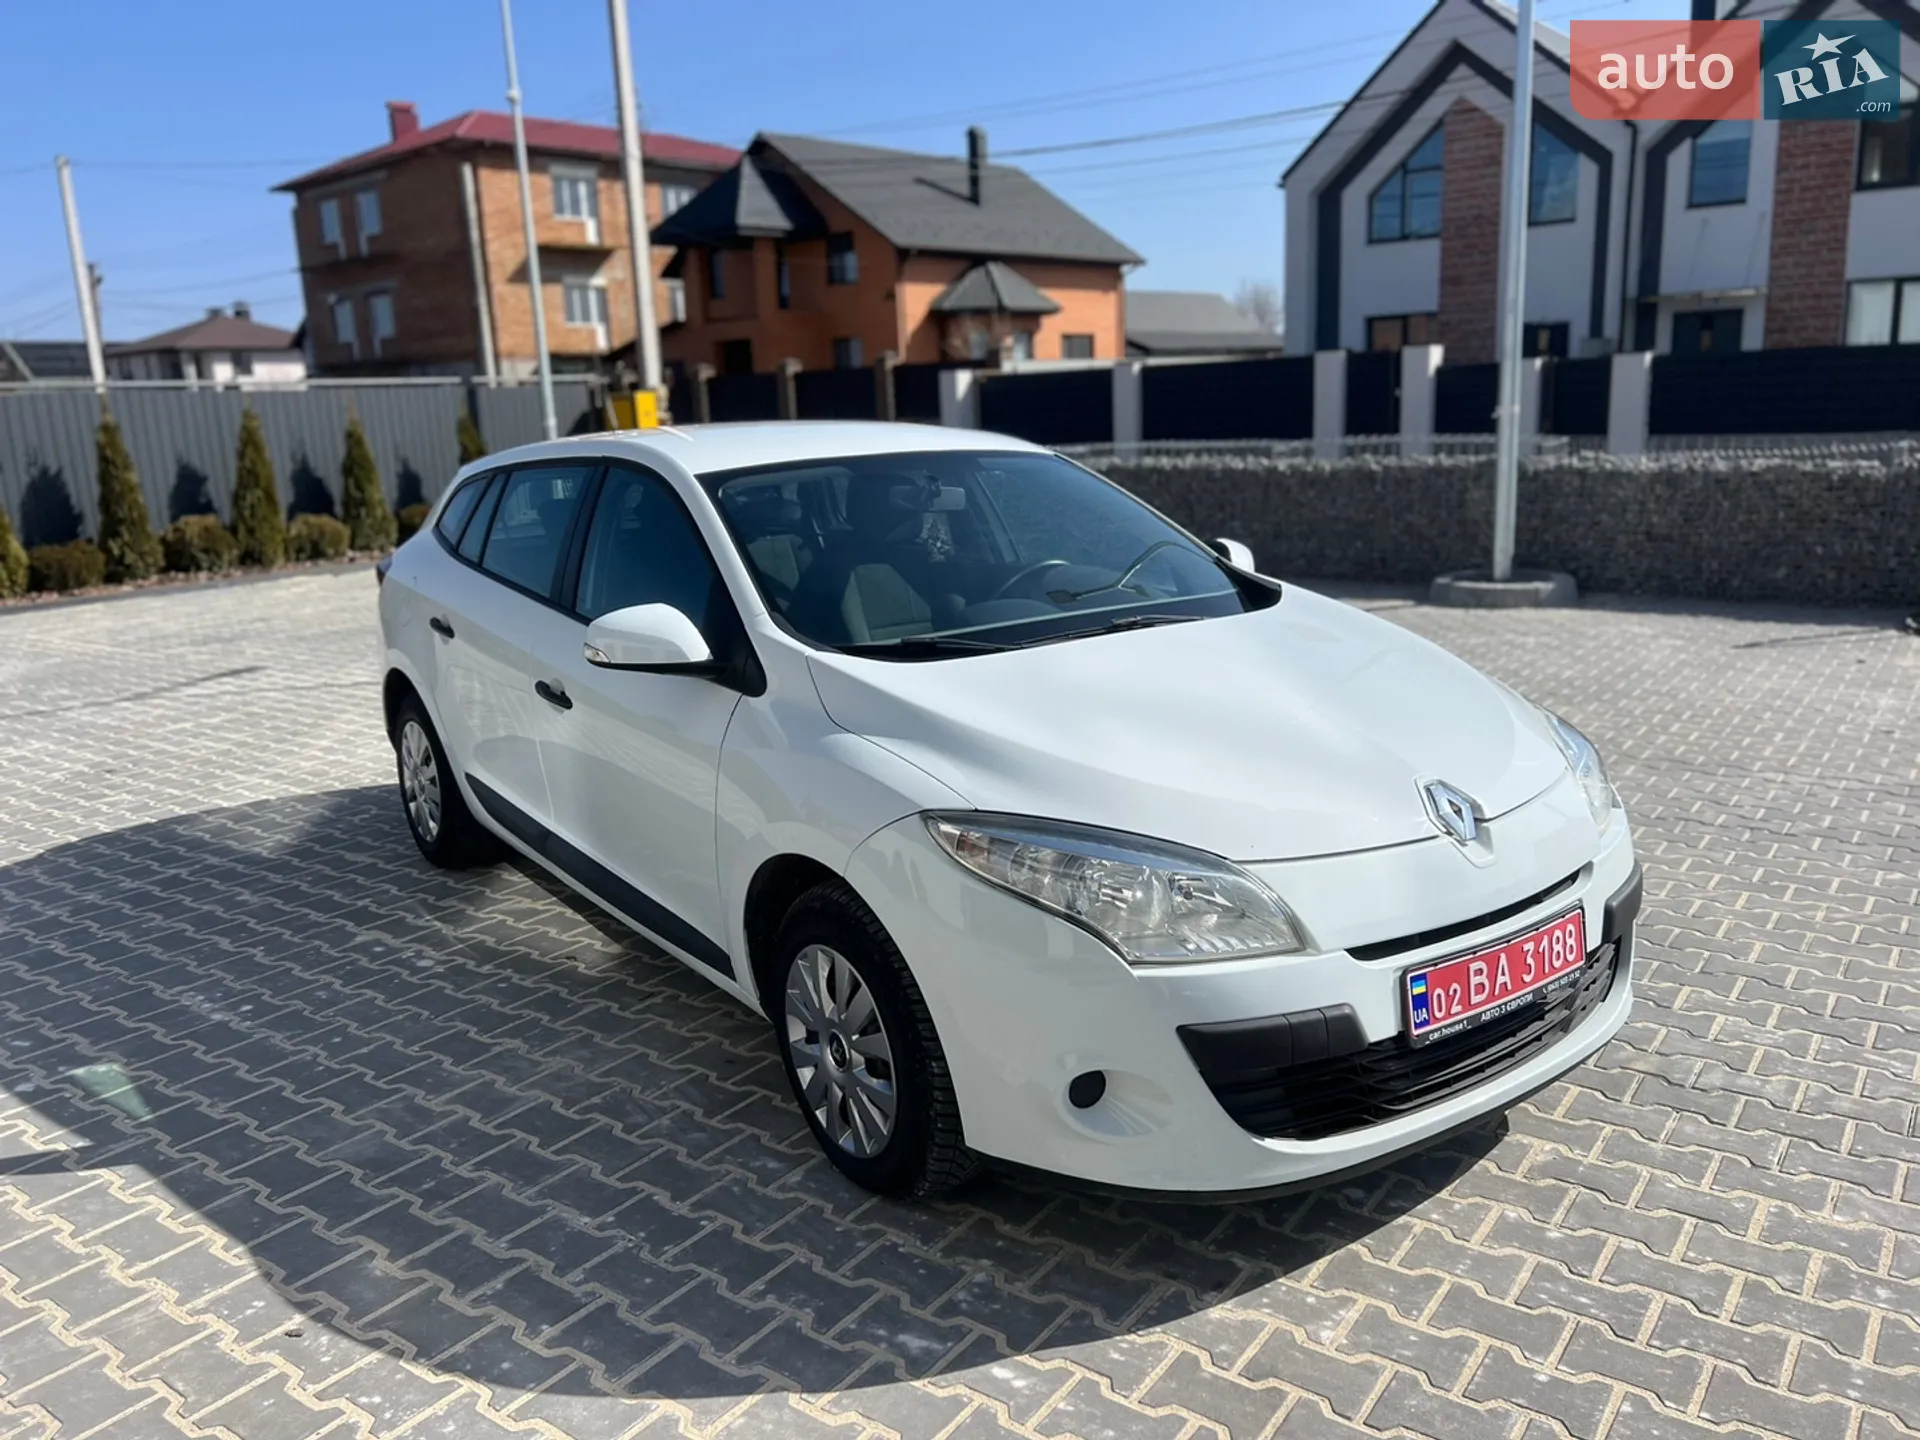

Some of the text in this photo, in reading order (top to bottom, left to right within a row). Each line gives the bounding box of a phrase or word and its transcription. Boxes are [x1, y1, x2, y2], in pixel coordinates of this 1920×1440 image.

[1433, 982, 1463, 1019] 02
[1468, 952, 1512, 1005] BA
[1521, 923, 1577, 984] 3188
[1413, 1008, 1429, 1024] UA
[1480, 1008, 1500, 1022] АВТО
